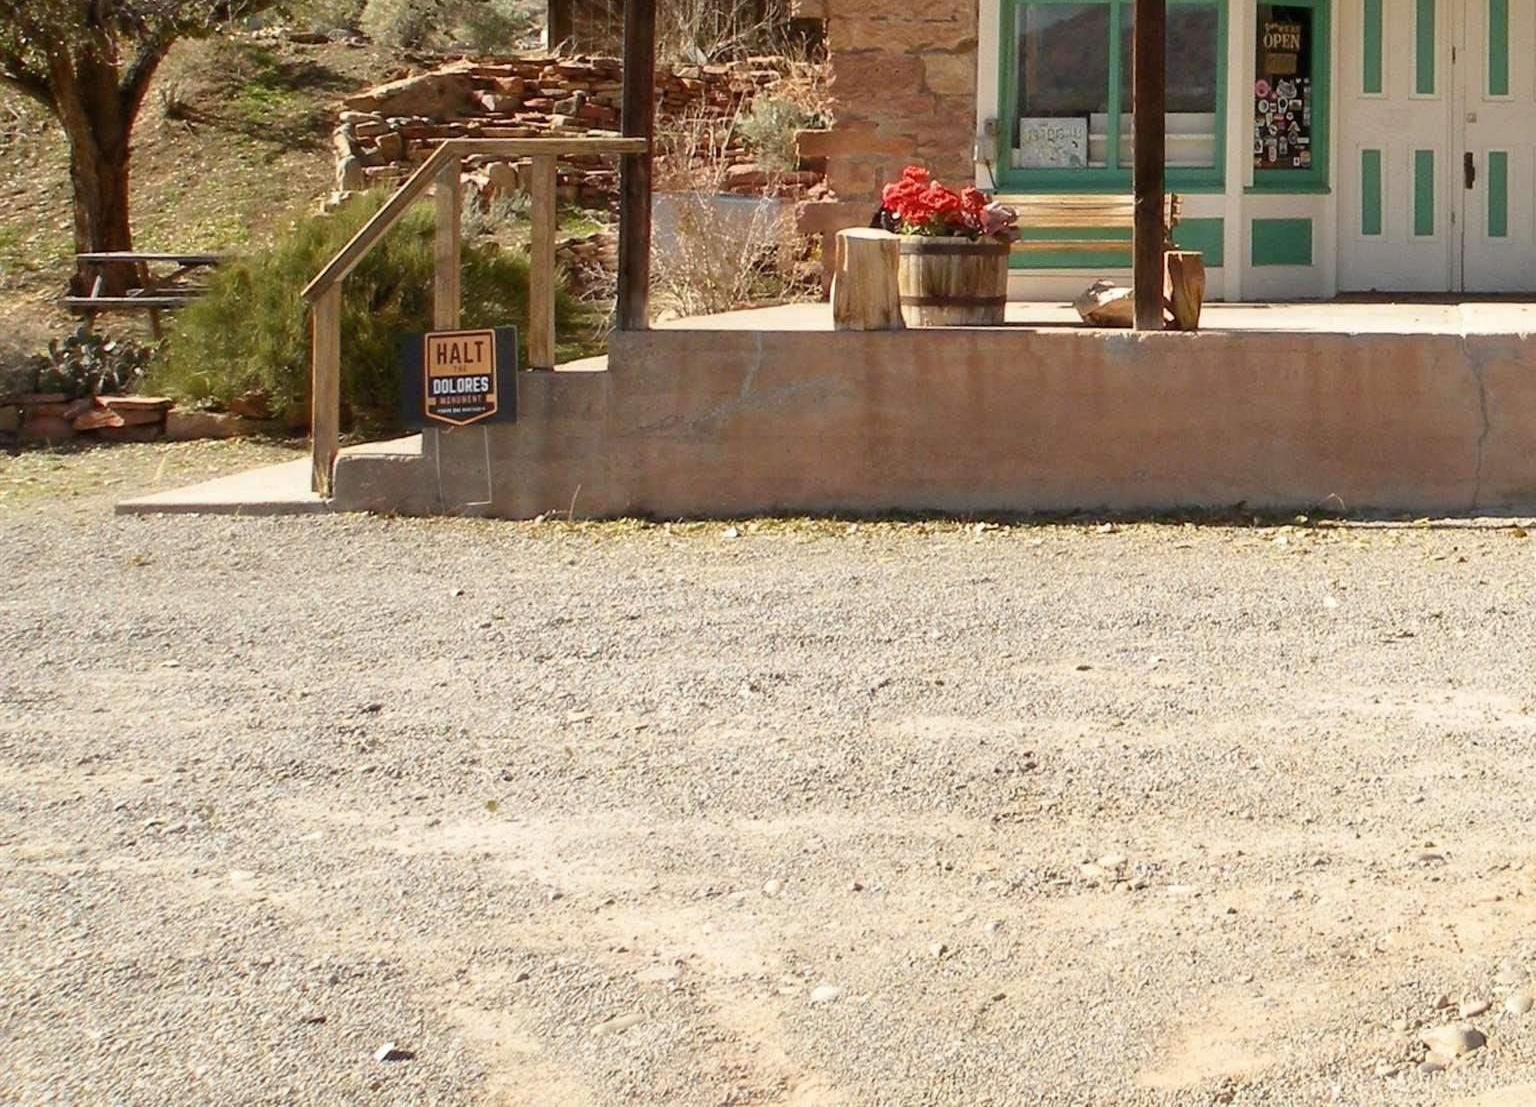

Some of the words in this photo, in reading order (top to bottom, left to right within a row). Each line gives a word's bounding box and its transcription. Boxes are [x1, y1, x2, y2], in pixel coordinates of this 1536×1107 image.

[1263, 33, 1300, 49] OPEN
[436, 341, 484, 365] HALT
[433, 376, 489, 395] DOLORES
